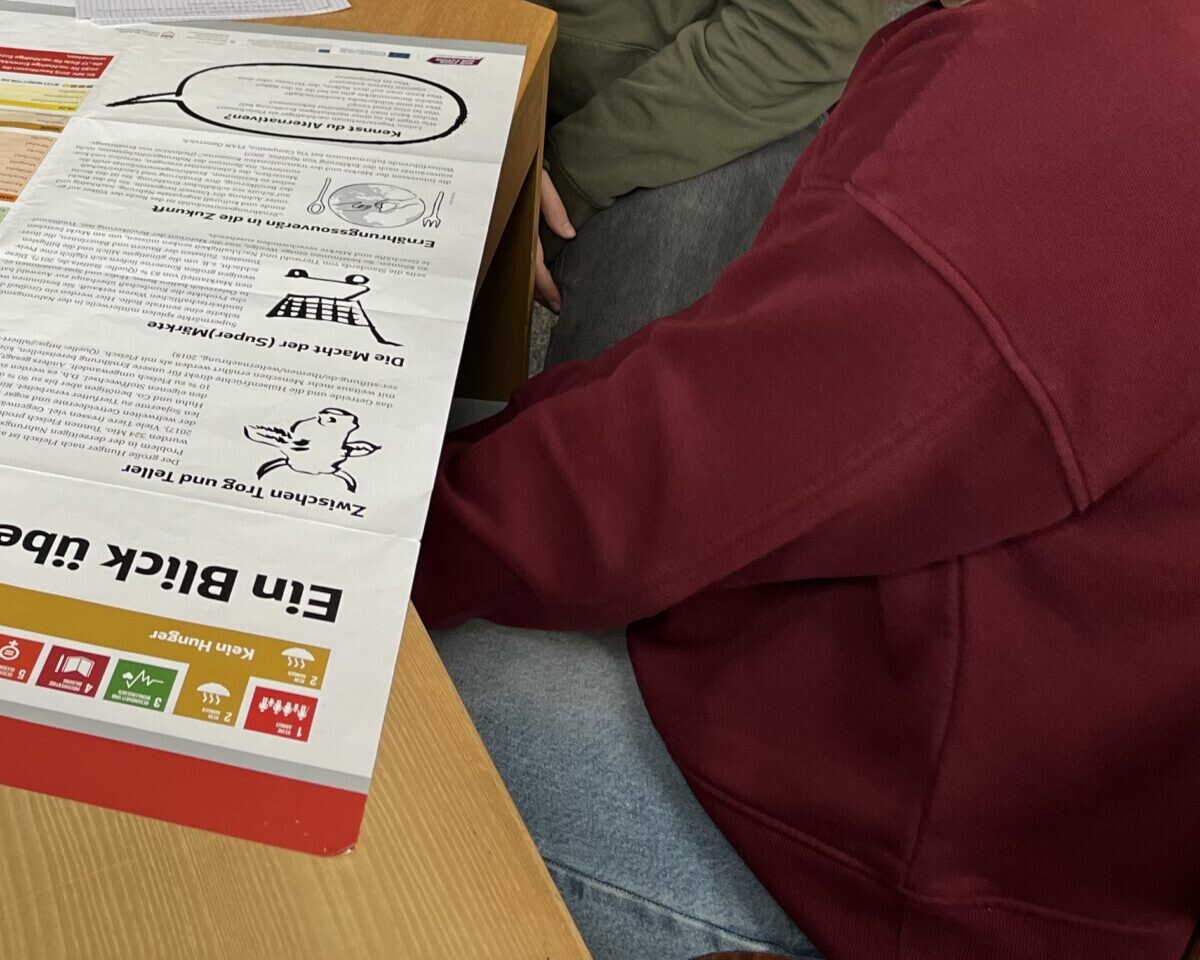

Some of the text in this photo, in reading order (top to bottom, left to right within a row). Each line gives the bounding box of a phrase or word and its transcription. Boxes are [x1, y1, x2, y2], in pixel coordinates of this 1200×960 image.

[223, 113, 401, 137] Kennst du Alternativen?
[151, 205, 435, 248] Ernährungssouverän in die Zukunft
[147, 321, 404, 367] Die Macht der (Super)Märkte
[32, 358, 66, 368] Anders
[78, 355, 130, 368] Ernährung
[10, 363, 44, 373] werden
[131, 363, 164, 373] unsere
[166, 369, 182, 377] für
[137, 373, 171, 384] Fleisch
[183, 371, 213, 381] direkt
[59, 380, 82, 389] aber
[215, 376, 286, 392] Hülsenfrüchte
[3, 391, 30, 399] sogar
[84, 384, 132, 397] benötigen
[147, 384, 186, 396] eigenen
[188, 391, 207, 399] den
[306, 389, 327, 397] und
[30, 395, 50, 403] und
[71, 392, 118, 405] Tierfutter
[175, 398, 203, 408] Huhn
[329, 393, 373, 405] Getreide
[52, 398, 120, 415] Getreideernte
[134, 402, 182, 415] Sojaernte
[375, 400, 393, 408] das
[69, 411, 105, 422] fressen
[122, 410, 176, 422] weltweiten
[183, 409, 199, 418] len
[27, 414, 62, 425] Fleisch
[106, 417, 132, 427] Tiere
[178, 418, 196, 426] der
[64, 420, 101, 432] Tonnen
[134, 422, 159, 431] Viele
[50, 428, 106, 443] derzeitigen
[128, 430, 146, 439] 324
[148, 433, 187, 444] wurden
[22, 434, 58, 446] Fleisch
[60, 440, 85, 448] nach
[107, 437, 125, 445] der
[86, 444, 126, 456] Hunger
[140, 442, 184, 455] Problem
[128, 451, 159, 461] große
[160, 456, 179, 465] Der
[123, 464, 365, 517] Zwischen Trog und Teller
[100, 544, 238, 602] Blick
[252, 573, 342, 622] Ein
[149, 630, 254, 660] Kein Hunger
[17, 669, 25, 679] 5
[309, 675, 317, 685] 2
[84, 683, 92, 693] 4
[153, 697, 161, 707] 3
[223, 711, 232, 722] 2
[296, 726, 301, 736] 1
